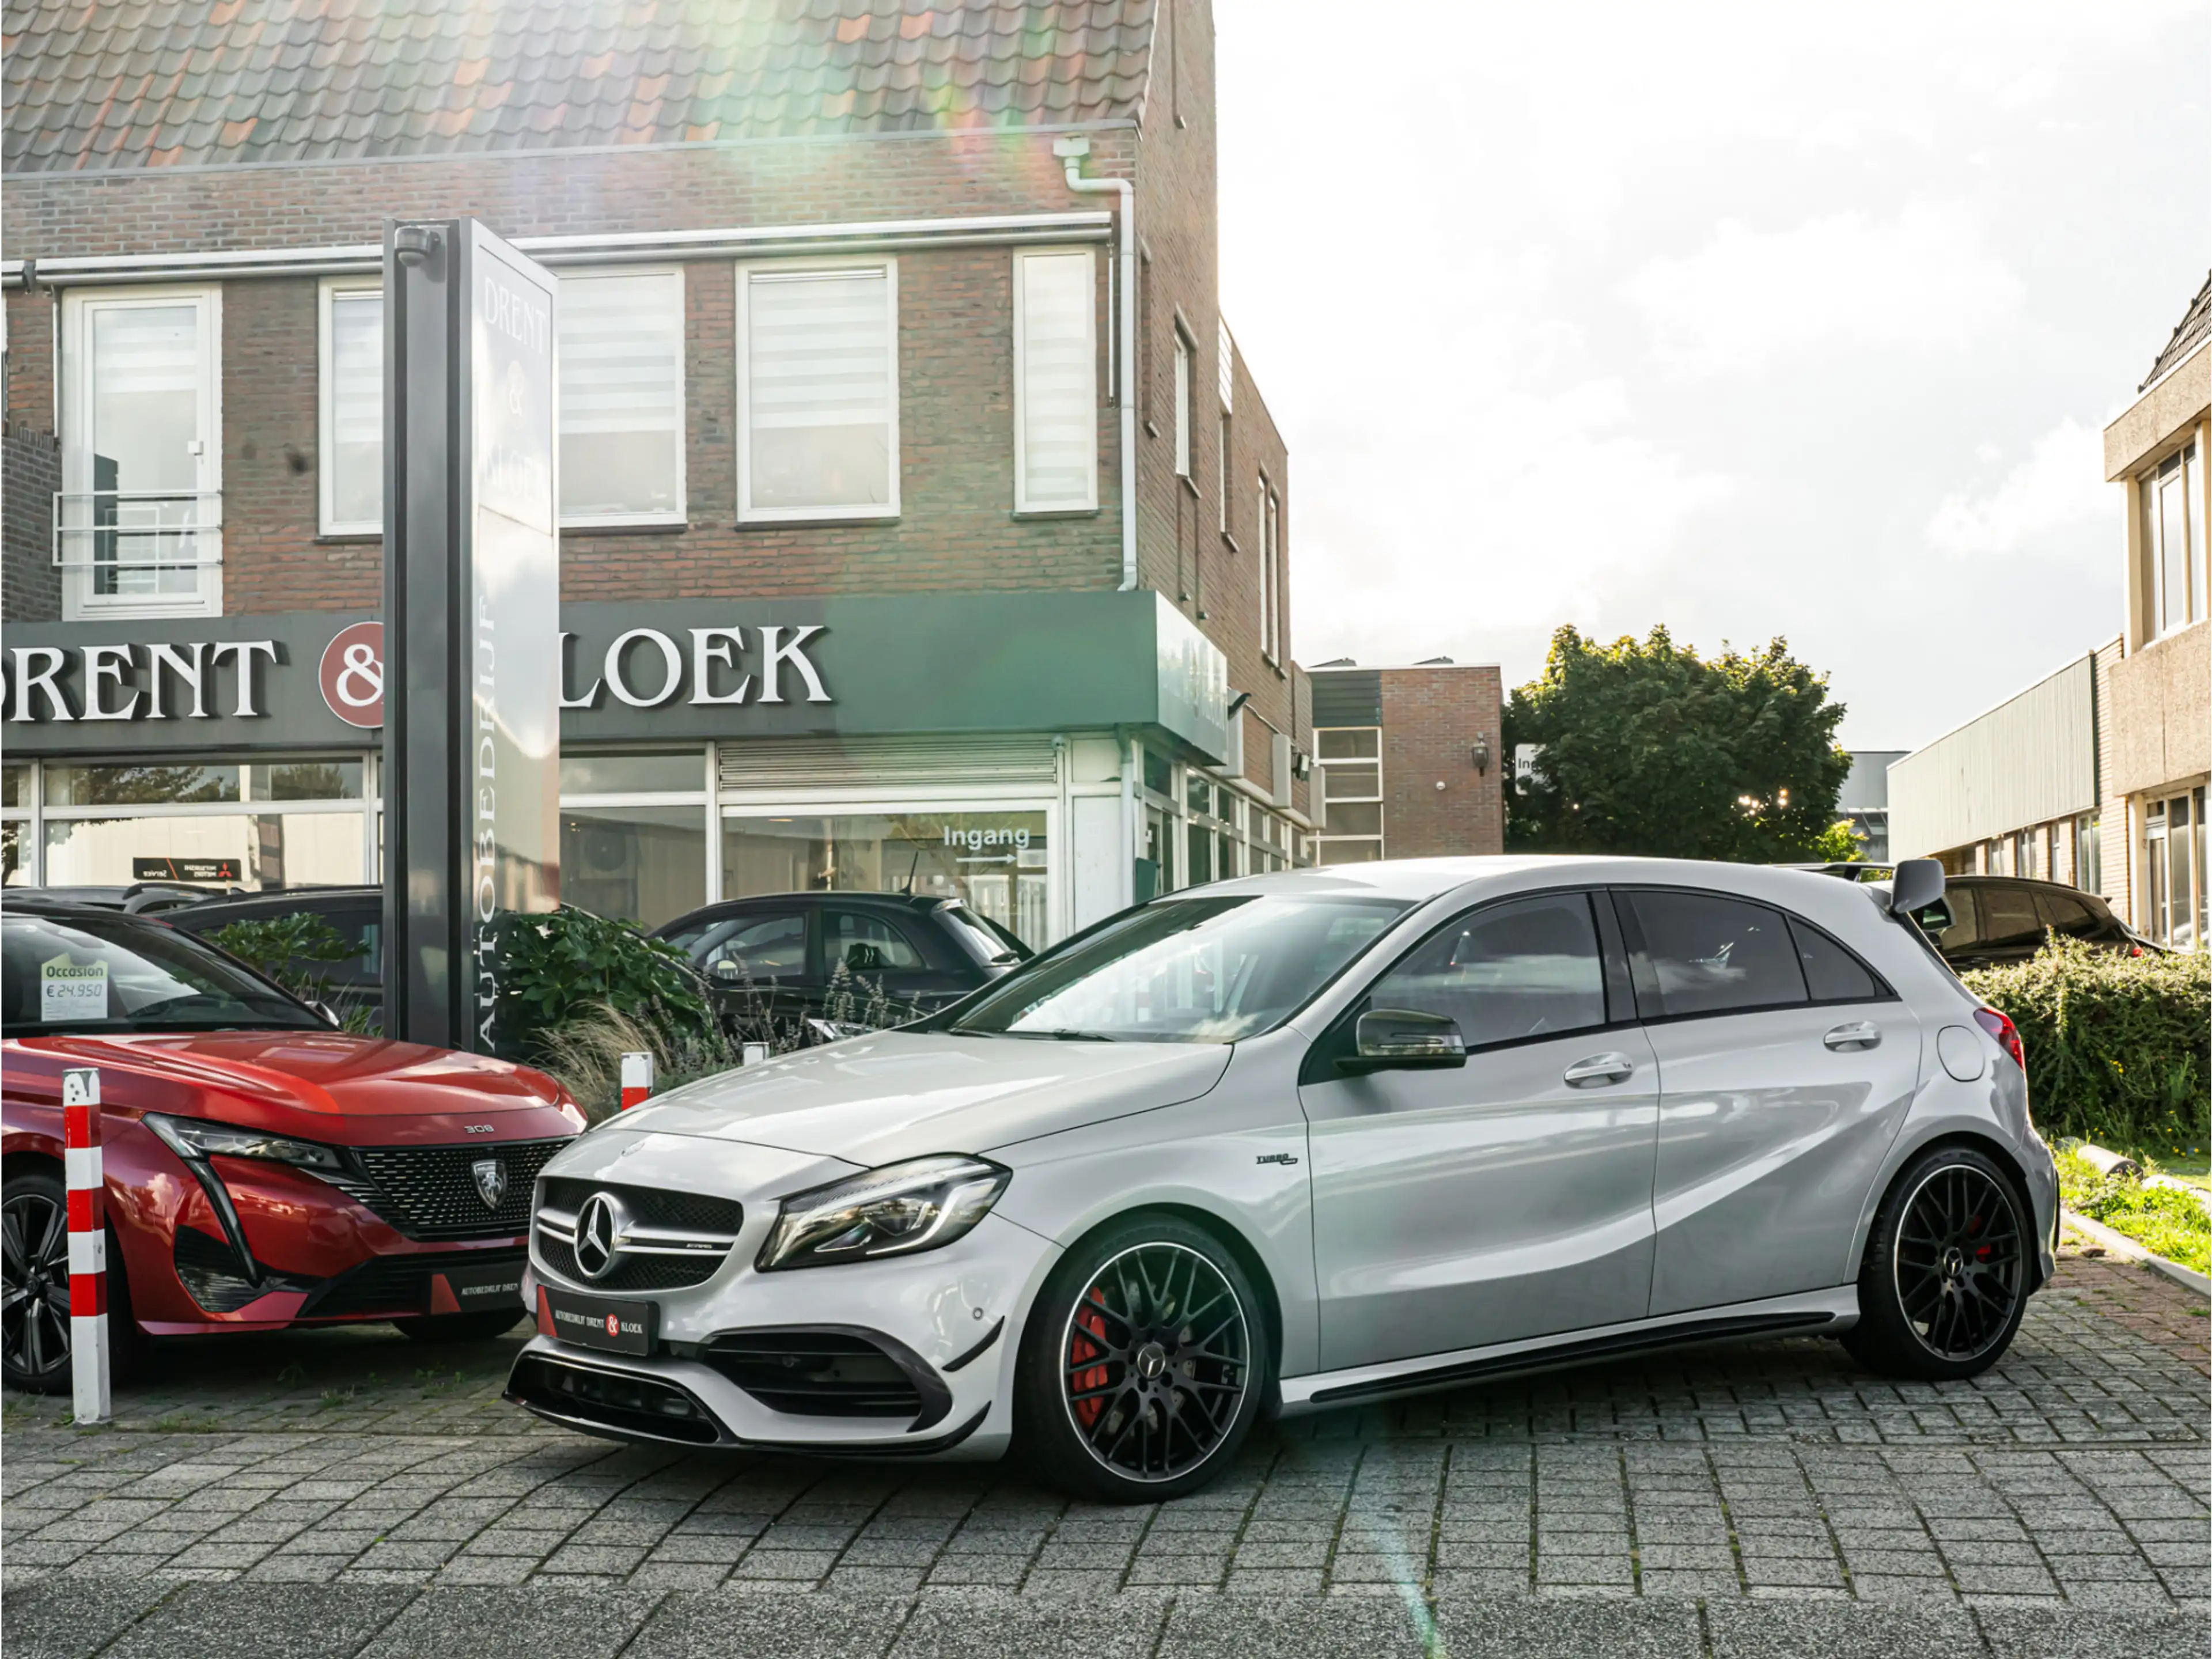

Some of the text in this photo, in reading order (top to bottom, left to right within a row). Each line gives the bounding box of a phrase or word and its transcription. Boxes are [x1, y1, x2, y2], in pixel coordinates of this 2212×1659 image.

[484, 277, 546, 354] DRENT
[2, 626, 832, 722] RENT & LOEK
[479, 595, 495, 1054] AUTOBEDRIJF
[944, 825, 1030, 850] Ingang
[46, 966, 103, 978] Occasion
[464, 1124, 494, 1134] 308
[608, 1316, 618, 1334] &
[621, 1321, 643, 1334] KLOEK
